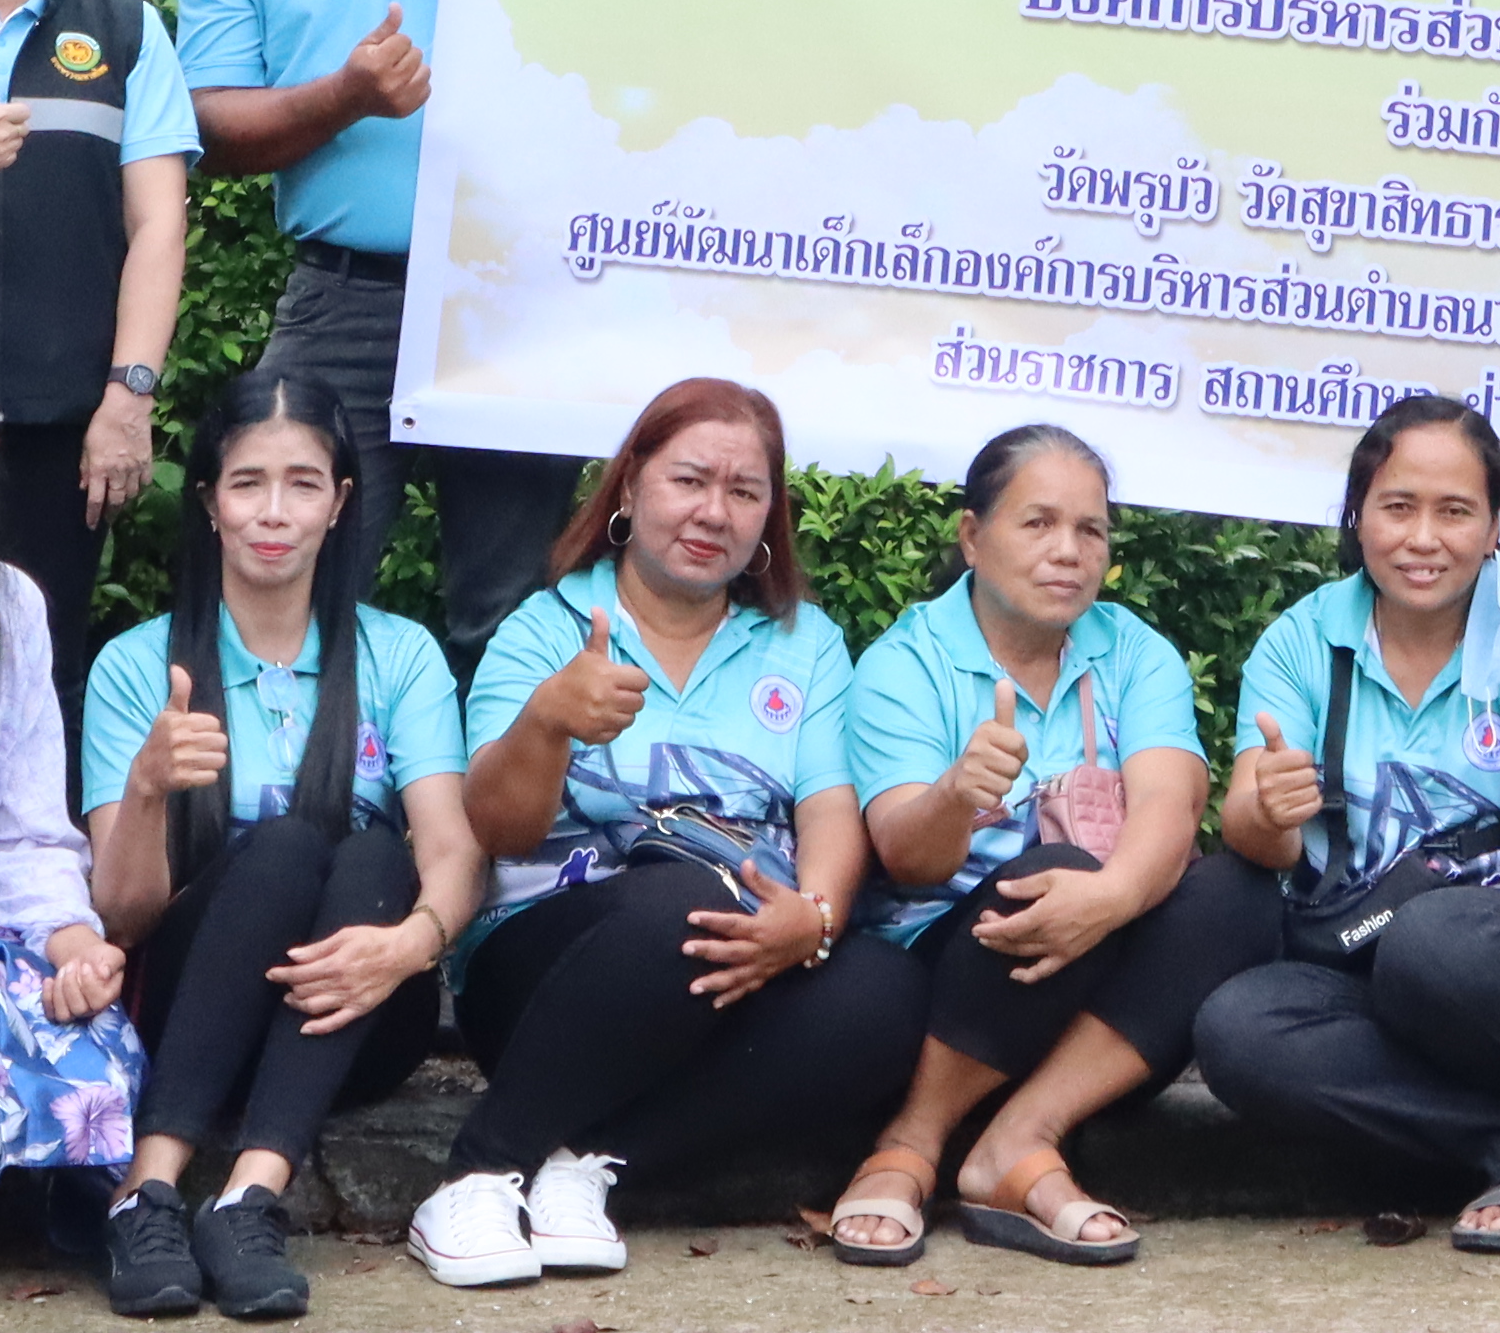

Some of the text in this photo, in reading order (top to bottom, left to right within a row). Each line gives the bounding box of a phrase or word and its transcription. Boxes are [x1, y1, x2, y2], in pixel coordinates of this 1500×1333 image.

[1043, 145, 1213, 229] วัดพรุบัว
[934, 328, 1172, 402] ส่วนราชการ
[1203, 363, 1432, 422] สถานศึก
[1340, 909, 1394, 947] Fashion
